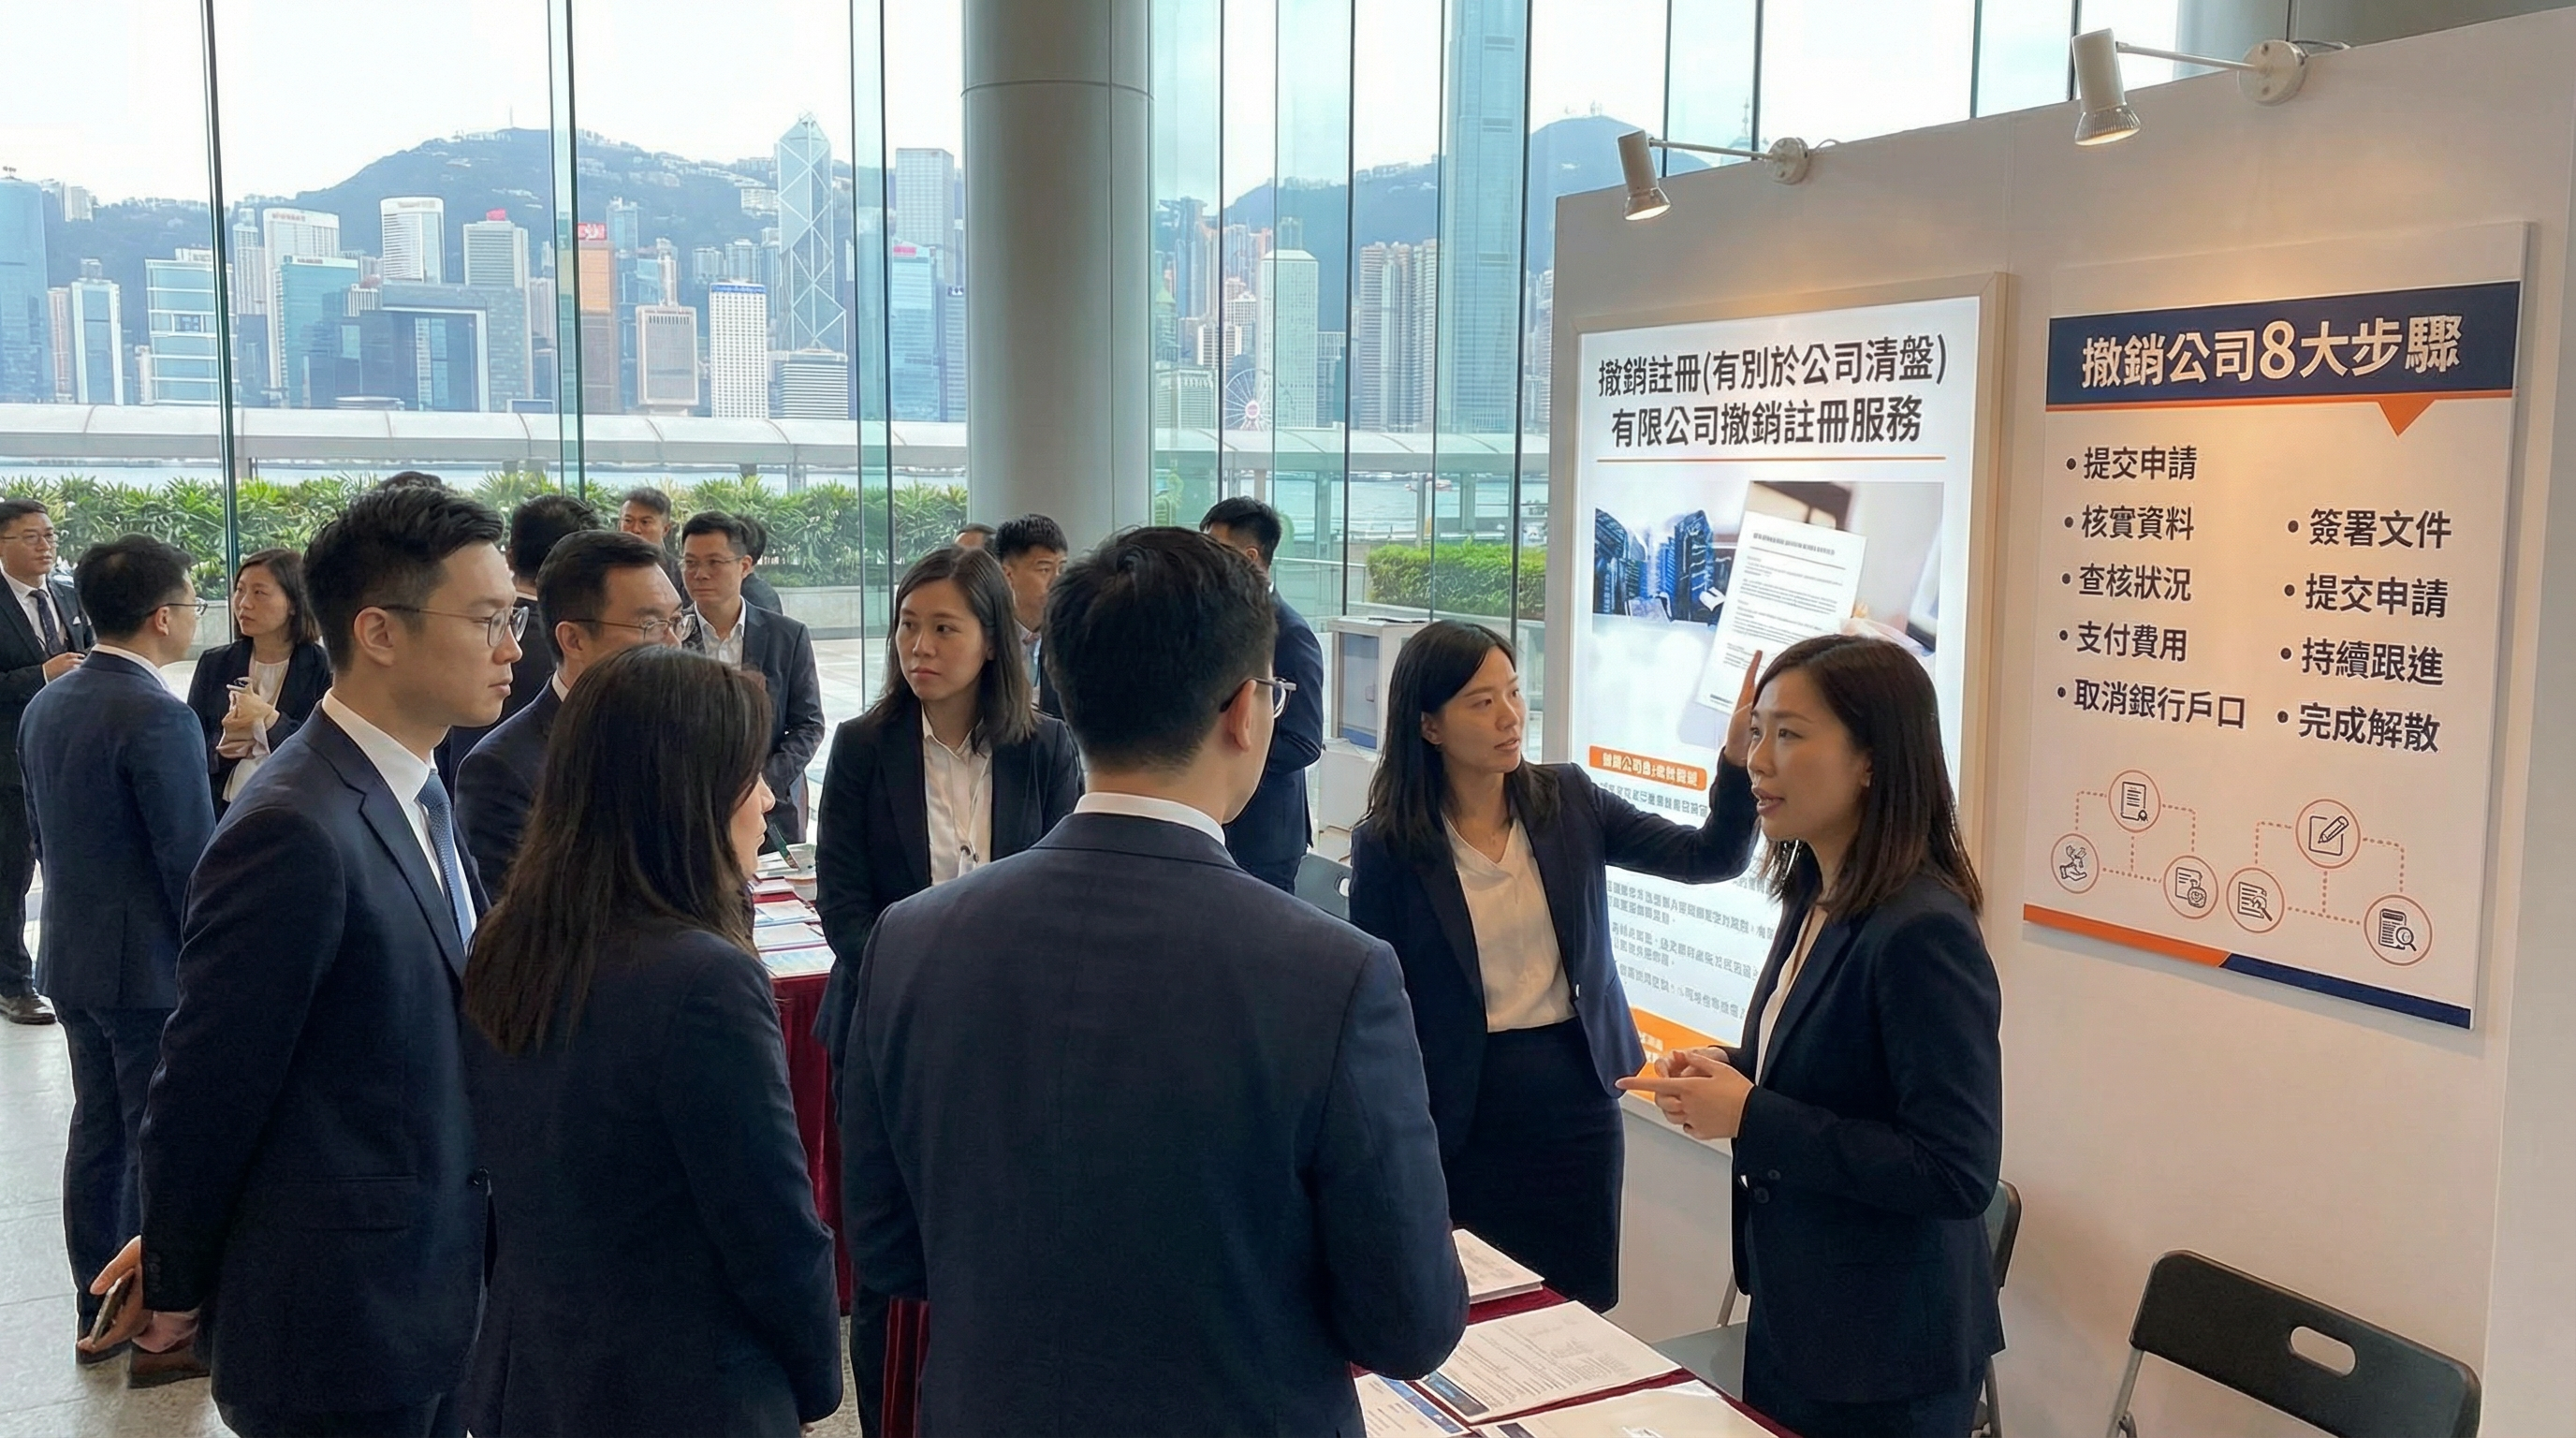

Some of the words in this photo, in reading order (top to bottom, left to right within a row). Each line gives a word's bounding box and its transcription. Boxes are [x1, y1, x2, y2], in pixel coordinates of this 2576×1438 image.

[1599, 333, 1947, 397] 撤銷註冊(有別於公司清盤)
[2082, 315, 2463, 389] 撤銷公司8大步驟
[1612, 394, 1923, 448] 有限公司撤銷註冊服務
[2083, 445, 2197, 480] 提交申請
[2081, 505, 2195, 541] 核實資料
[2309, 508, 2452, 550] 簽署文件
[2079, 563, 2192, 602] 查核狀況
[2305, 573, 2449, 619] 提交申請
[2076, 620, 2188, 662] 支付費用
[2302, 637, 2444, 686] 持續跟進
[2073, 679, 2246, 729] 取消銀行戶口
[2299, 702, 2441, 753] 完成解散
